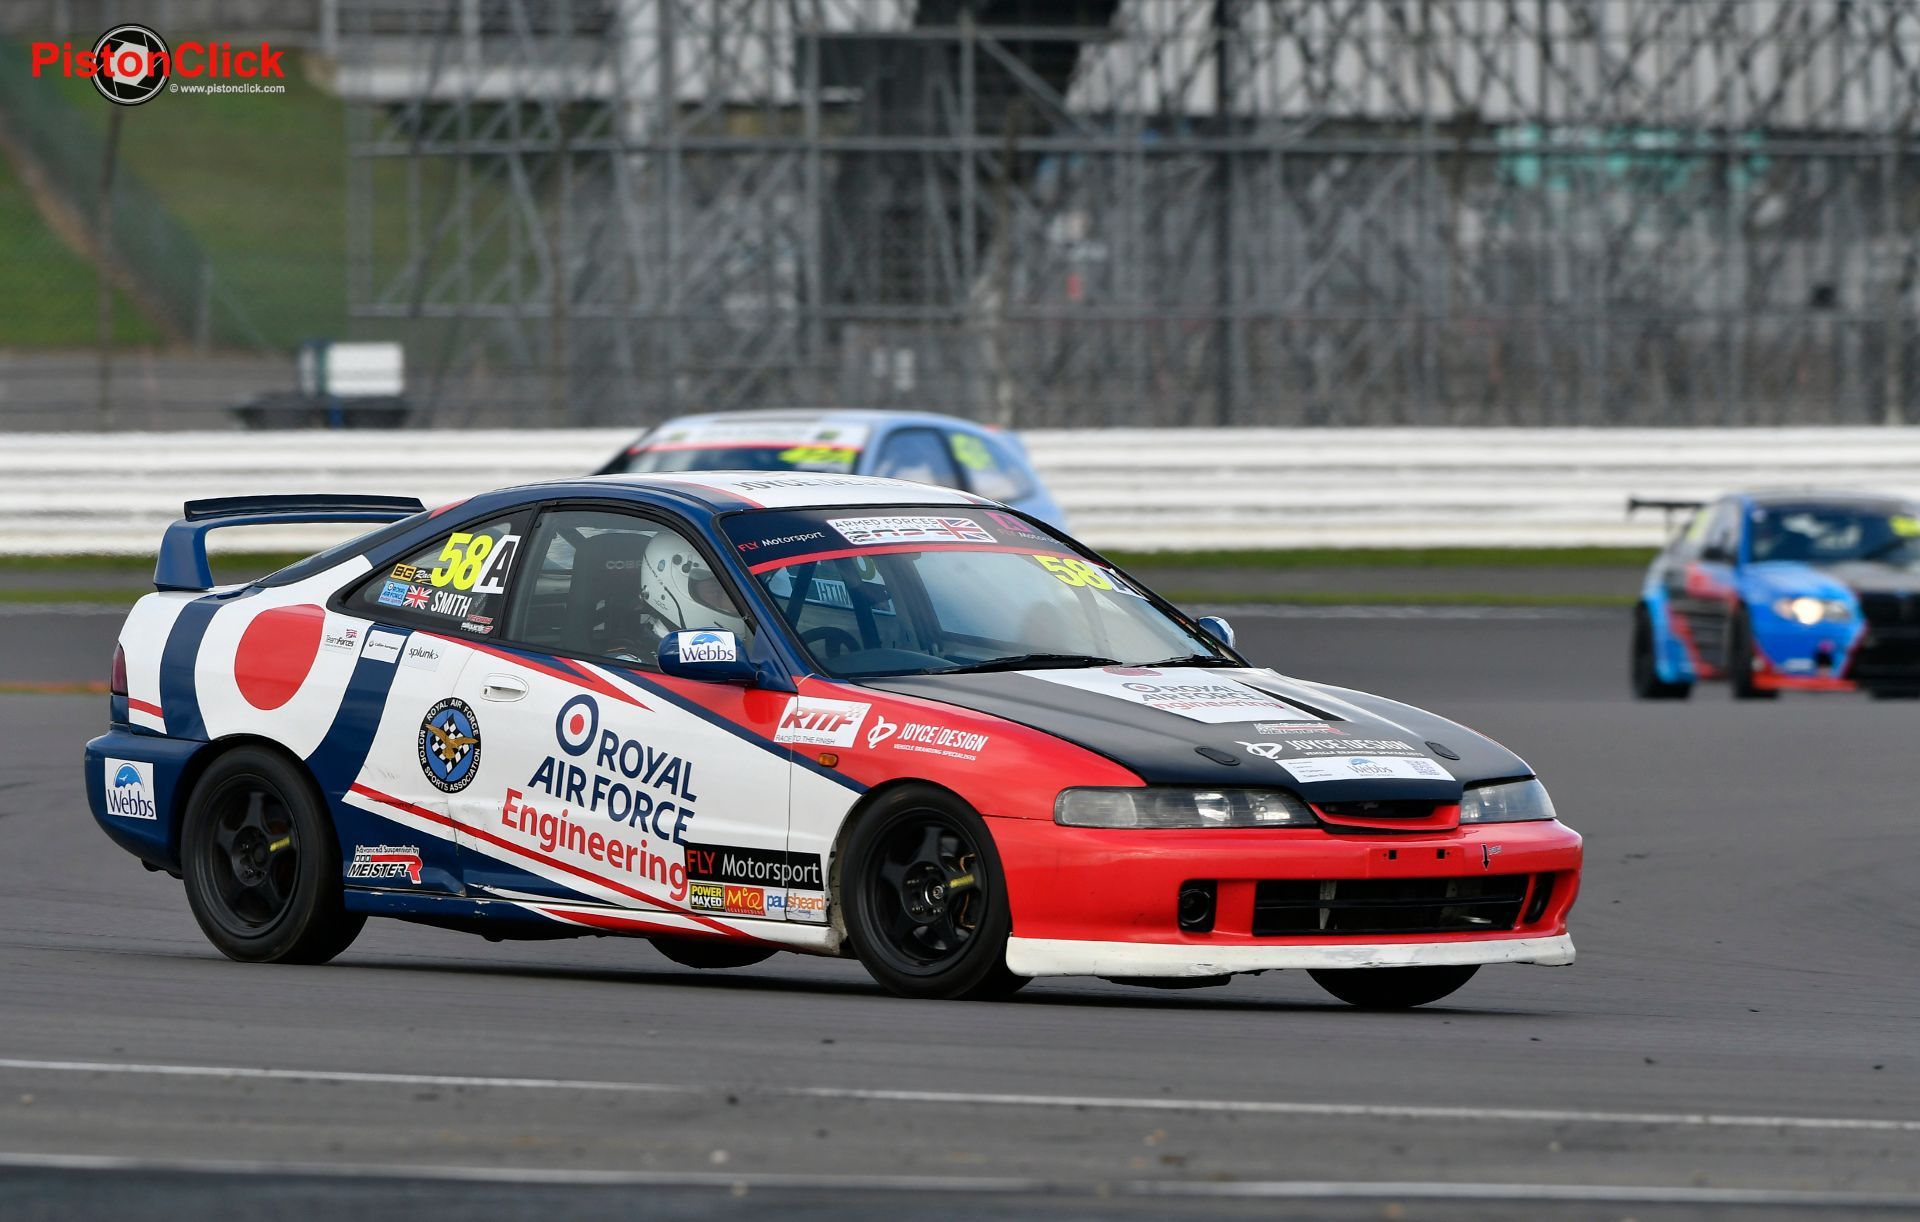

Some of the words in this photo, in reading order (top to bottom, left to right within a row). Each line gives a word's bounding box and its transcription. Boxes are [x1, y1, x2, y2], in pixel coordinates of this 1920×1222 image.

[835, 519, 881, 528] ARMED
[738, 541, 760, 552] FLY
[761, 531, 826, 547] Motorsport
[430, 532, 493, 590] 58
[1032, 554, 1113, 591] 58
[431, 590, 473, 618] SMITH
[682, 645, 734, 661] Webbs
[427, 700, 448, 721] ROYAL
[450, 699, 463, 709] AIR
[463, 705, 479, 737] FORCE
[803, 735, 815, 743] THE
[418, 729, 428, 765] MOTOR
[424, 766, 449, 792] SPORTS
[449, 748, 481, 792] ASSOCIATION
[596, 728, 697, 803] ROYAL
[1347, 764, 1394, 774] Webbs
[107, 789, 155, 818] Webbs
[527, 755, 586, 808] AIR
[590, 774, 696, 846] FORCE
[356, 845, 382, 854] Advanced
[383, 845, 412, 855] Suspension
[501, 787, 688, 901] Engineering
[686, 849, 716, 875] FLY
[721, 853, 821, 887] Motorsport
[691, 885, 722, 897] POWER
[691, 896, 722, 908] MAXED
